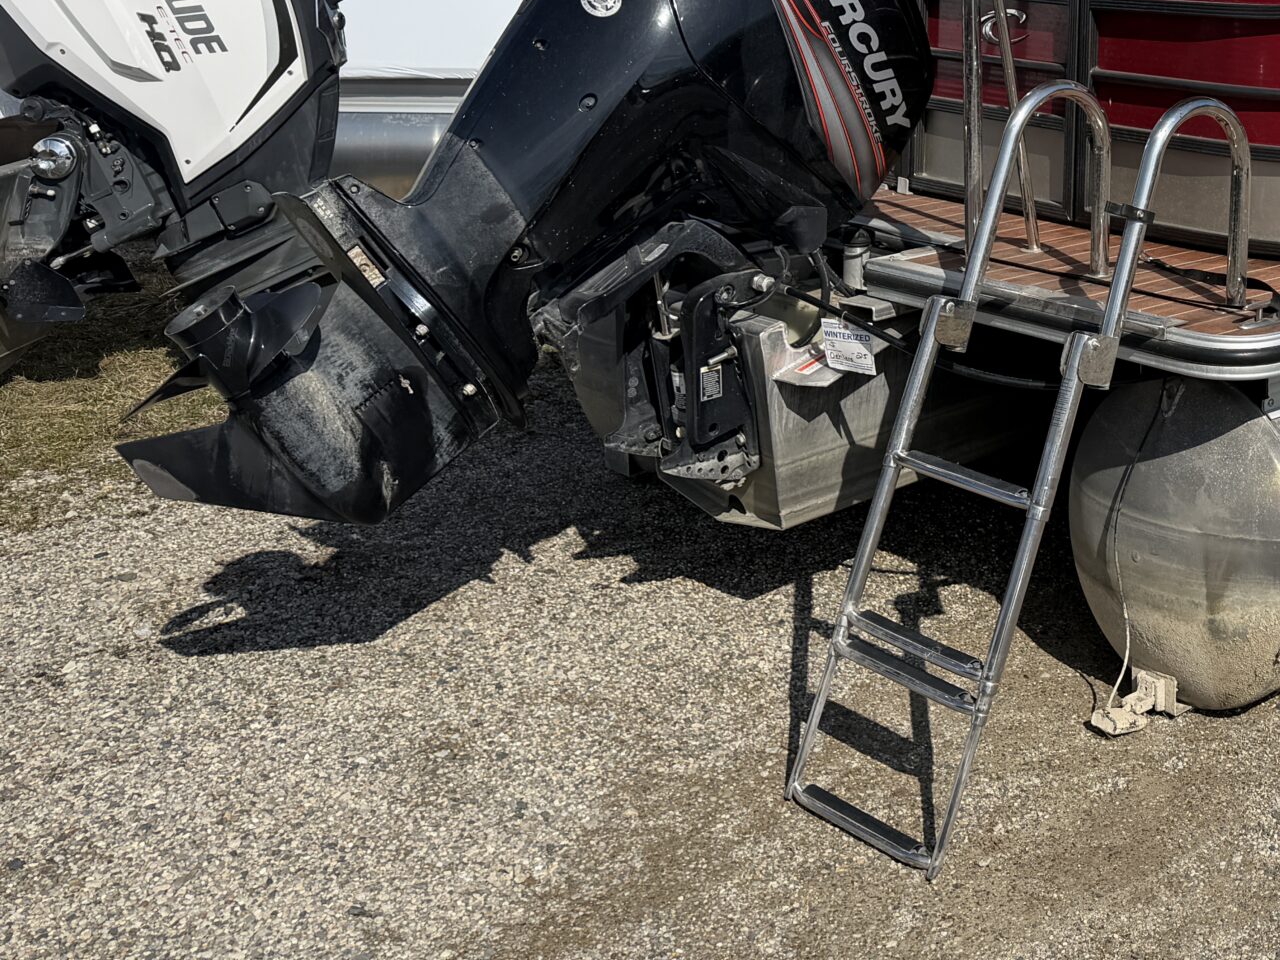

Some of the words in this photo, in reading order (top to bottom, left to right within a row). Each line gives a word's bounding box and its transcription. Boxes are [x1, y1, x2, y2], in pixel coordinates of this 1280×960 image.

[156, 5, 194, 64] E-TEC
[820, 21, 883, 145] FOURSTROKE
[824, 330, 871, 342] WINTERIZED
